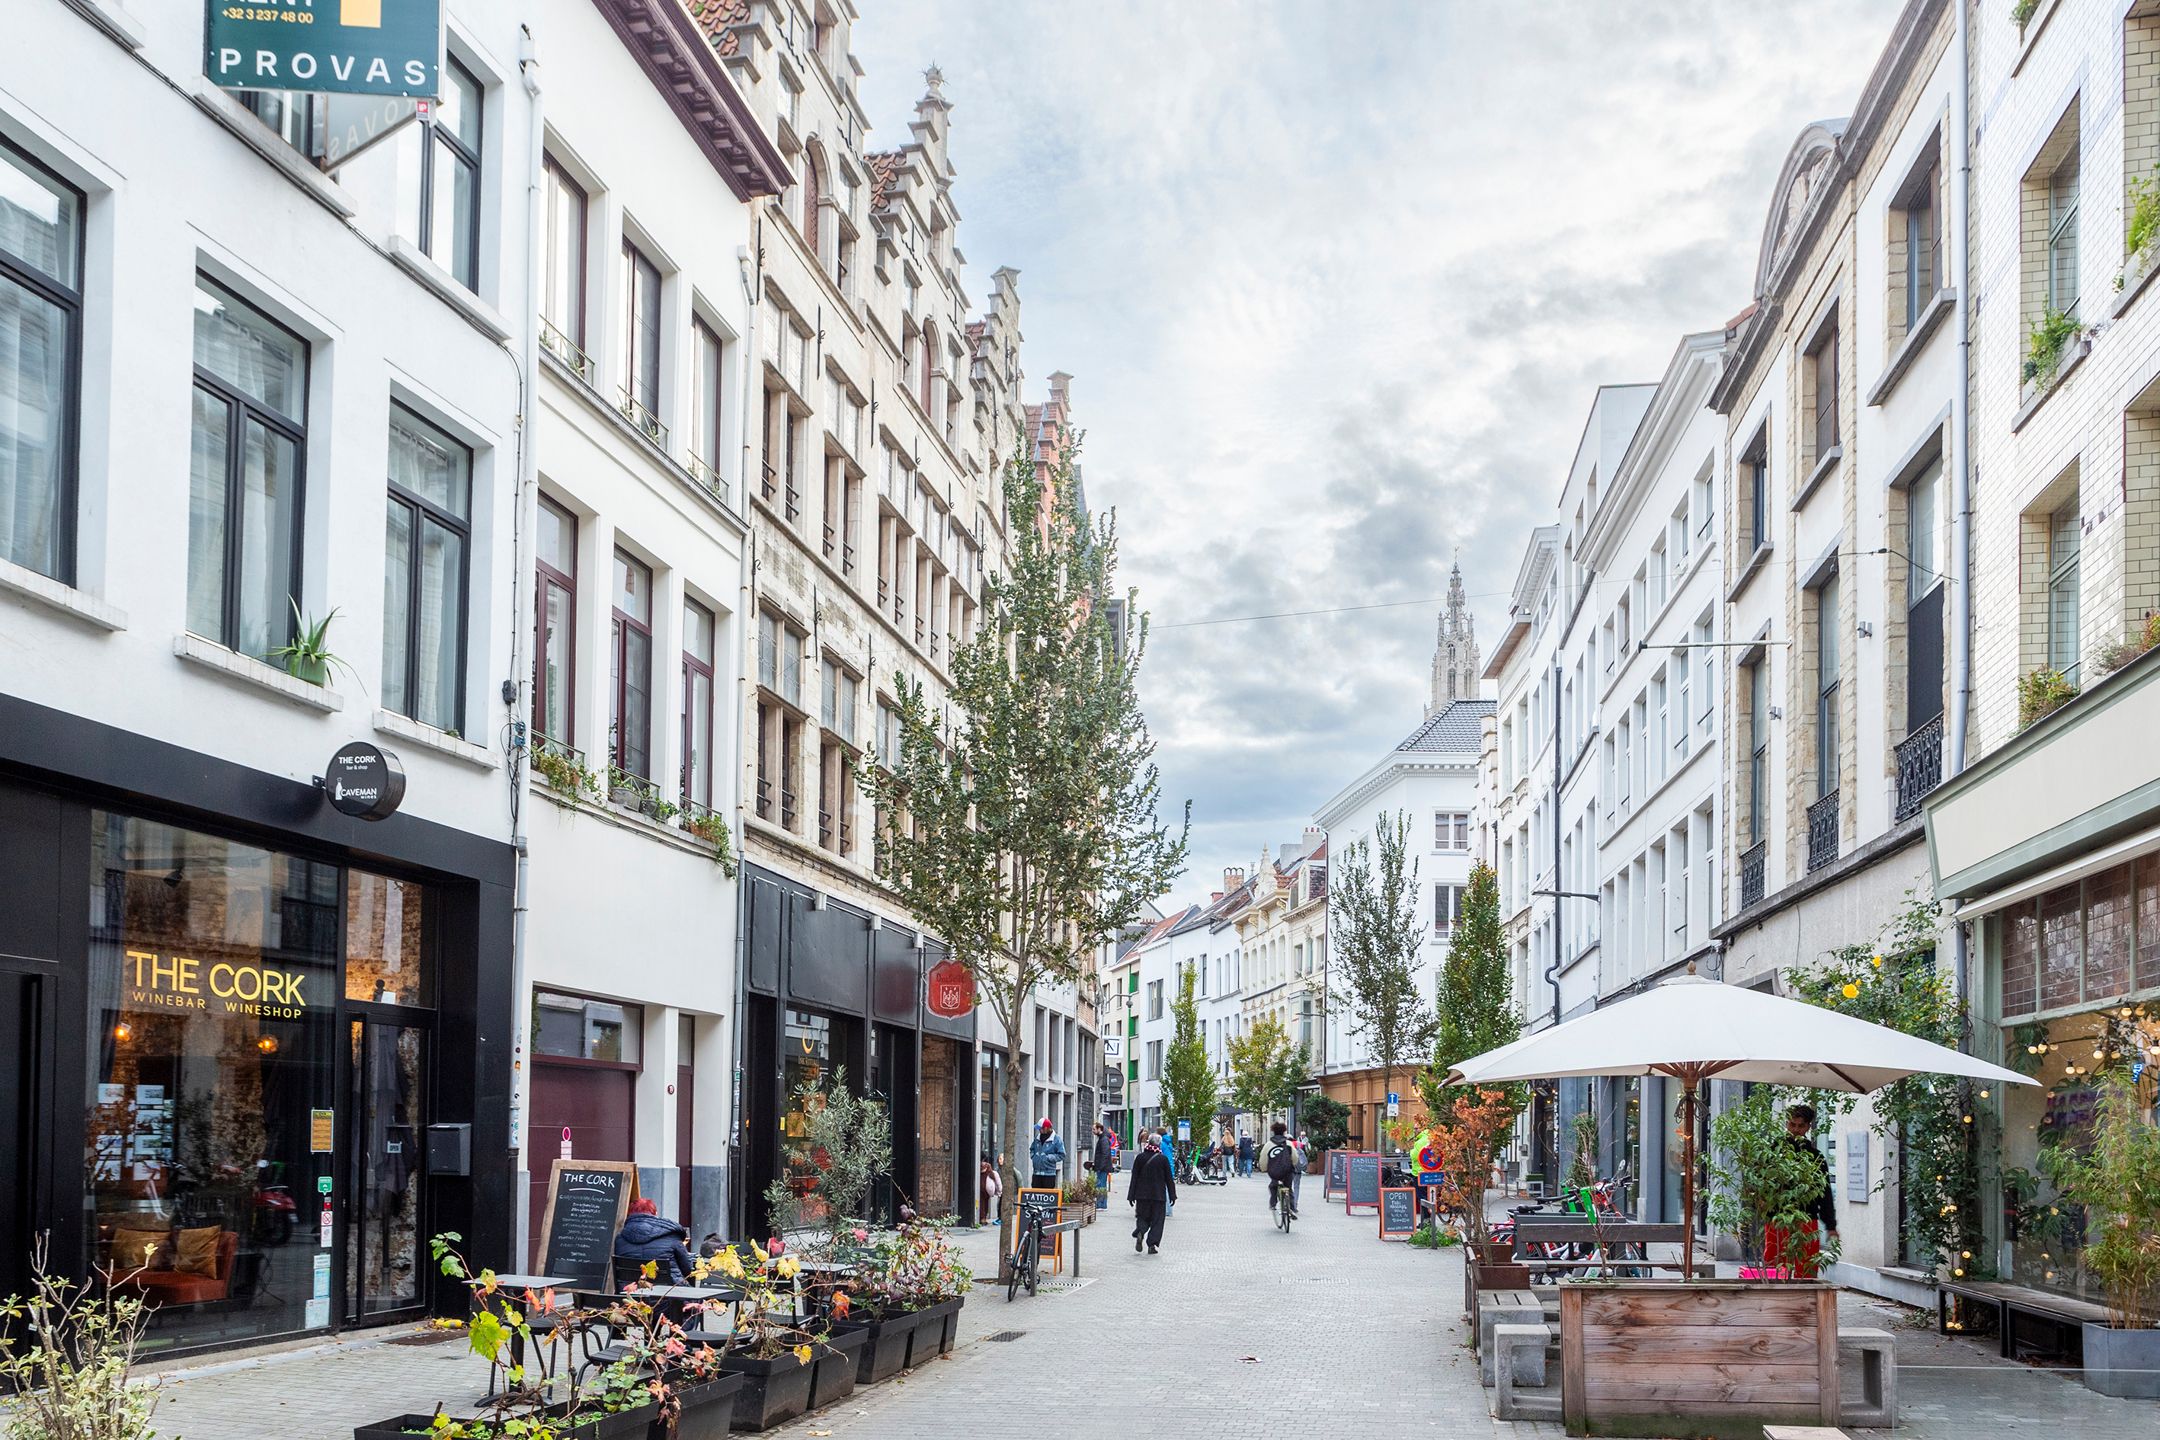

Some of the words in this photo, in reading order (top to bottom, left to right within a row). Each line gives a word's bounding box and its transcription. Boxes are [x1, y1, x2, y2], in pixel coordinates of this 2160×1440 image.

[222, 8, 244, 20] +32
[245, 8, 255, 20] 3
[256, 9, 279, 22] 237
[280, 11, 297, 23] 48
[297, 12, 314, 24] 00
[220, 48, 427, 86] PROVAS
[338, 756, 354, 764] THE
[354, 755, 376, 764] CORK
[341, 788, 377, 796] CAVEMAN
[126, 950, 200, 994] THE
[209, 963, 307, 1007] CORK
[132, 991, 206, 1010] WINEBAR
[225, 1001, 302, 1019] WINESHOP
[564, 1173, 584, 1183] THE
[585, 1174, 615, 1188] CORK
[1024, 1193, 1055, 1202] TATTOO
[1389, 1192, 1407, 1200] OPEN
